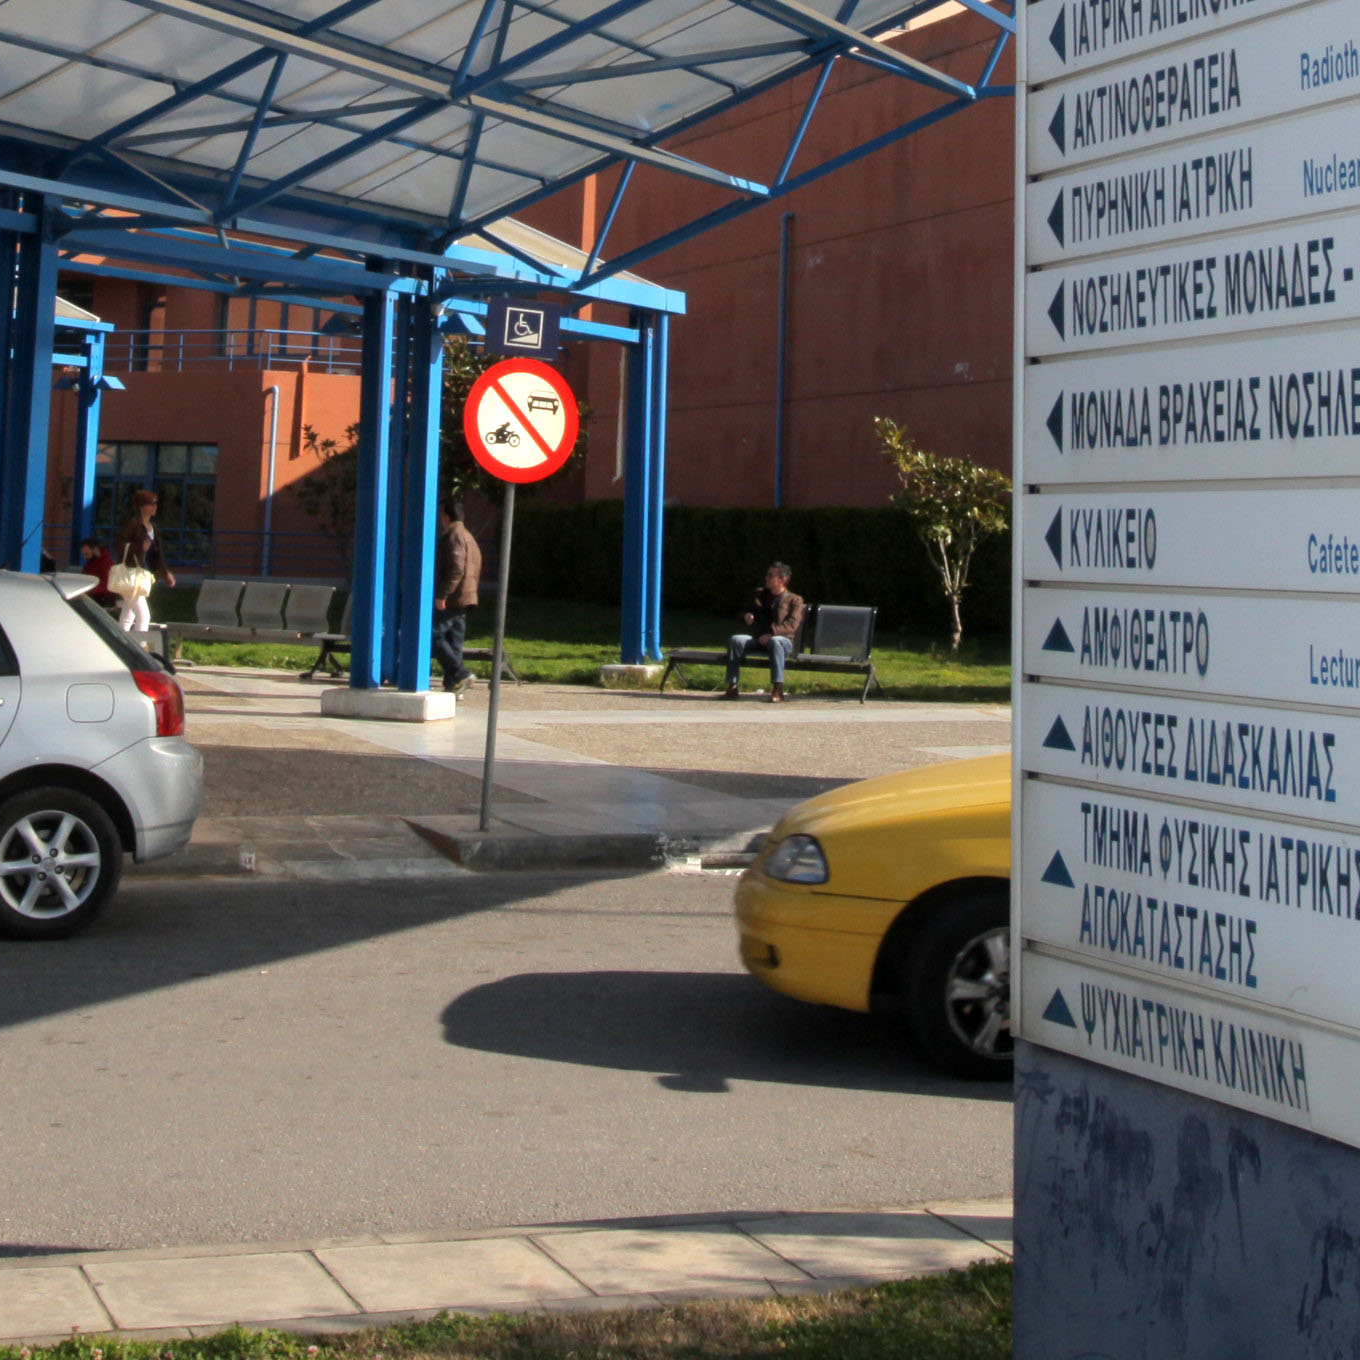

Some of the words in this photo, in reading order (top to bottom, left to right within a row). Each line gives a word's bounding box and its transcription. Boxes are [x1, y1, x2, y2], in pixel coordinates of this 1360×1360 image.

[1072, 48, 1241, 150] ΑΚΤΙΝΟΘΕΡΑΠΕΙΑ
[1071, 167, 1166, 244] ΠΥΡΗΝΙΚΗ
[1172, 146, 1254, 223] ΙΑΤΡΙΚΗ
[1072, 257, 1218, 337] ΝΟΣΗΛΕΥΤΙΚΕΣ
[1225, 237, 1336, 317] ΜΟΝΑΔΕΣ
[1342, 267, 1354, 282] -
[1070, 386, 1152, 451] ΜΟΝΑΔΑ
[1158, 376, 1261, 447] ΒΡΑΧΕΙΑΣ
[1070, 507, 1157, 570] ΚΥΛΙΚΕΙΟ
[1079, 606, 1210, 677] ΑΜΦΙΘΕΑΤΡΟ
[1081, 705, 1178, 778] ΑΙΘΟΥΣΕΣ
[1184, 717, 1337, 803] ΔΙΔΑΣΚΑΛΙΑΣ
[1080, 802, 1153, 877] ΤΜΗΜΑ
[1159, 816, 1251, 898] ΦΥΣΙΚΗΣ
[1079, 882, 1258, 989] ΑΠΟΚΑΤΑΣΤΑΣΗΣ
[1080, 981, 1207, 1081] ΨΥΧΙΑΤΡΙΚΗ
[1210, 1017, 1311, 1113] ΚΛΙΝΙΚΗ
